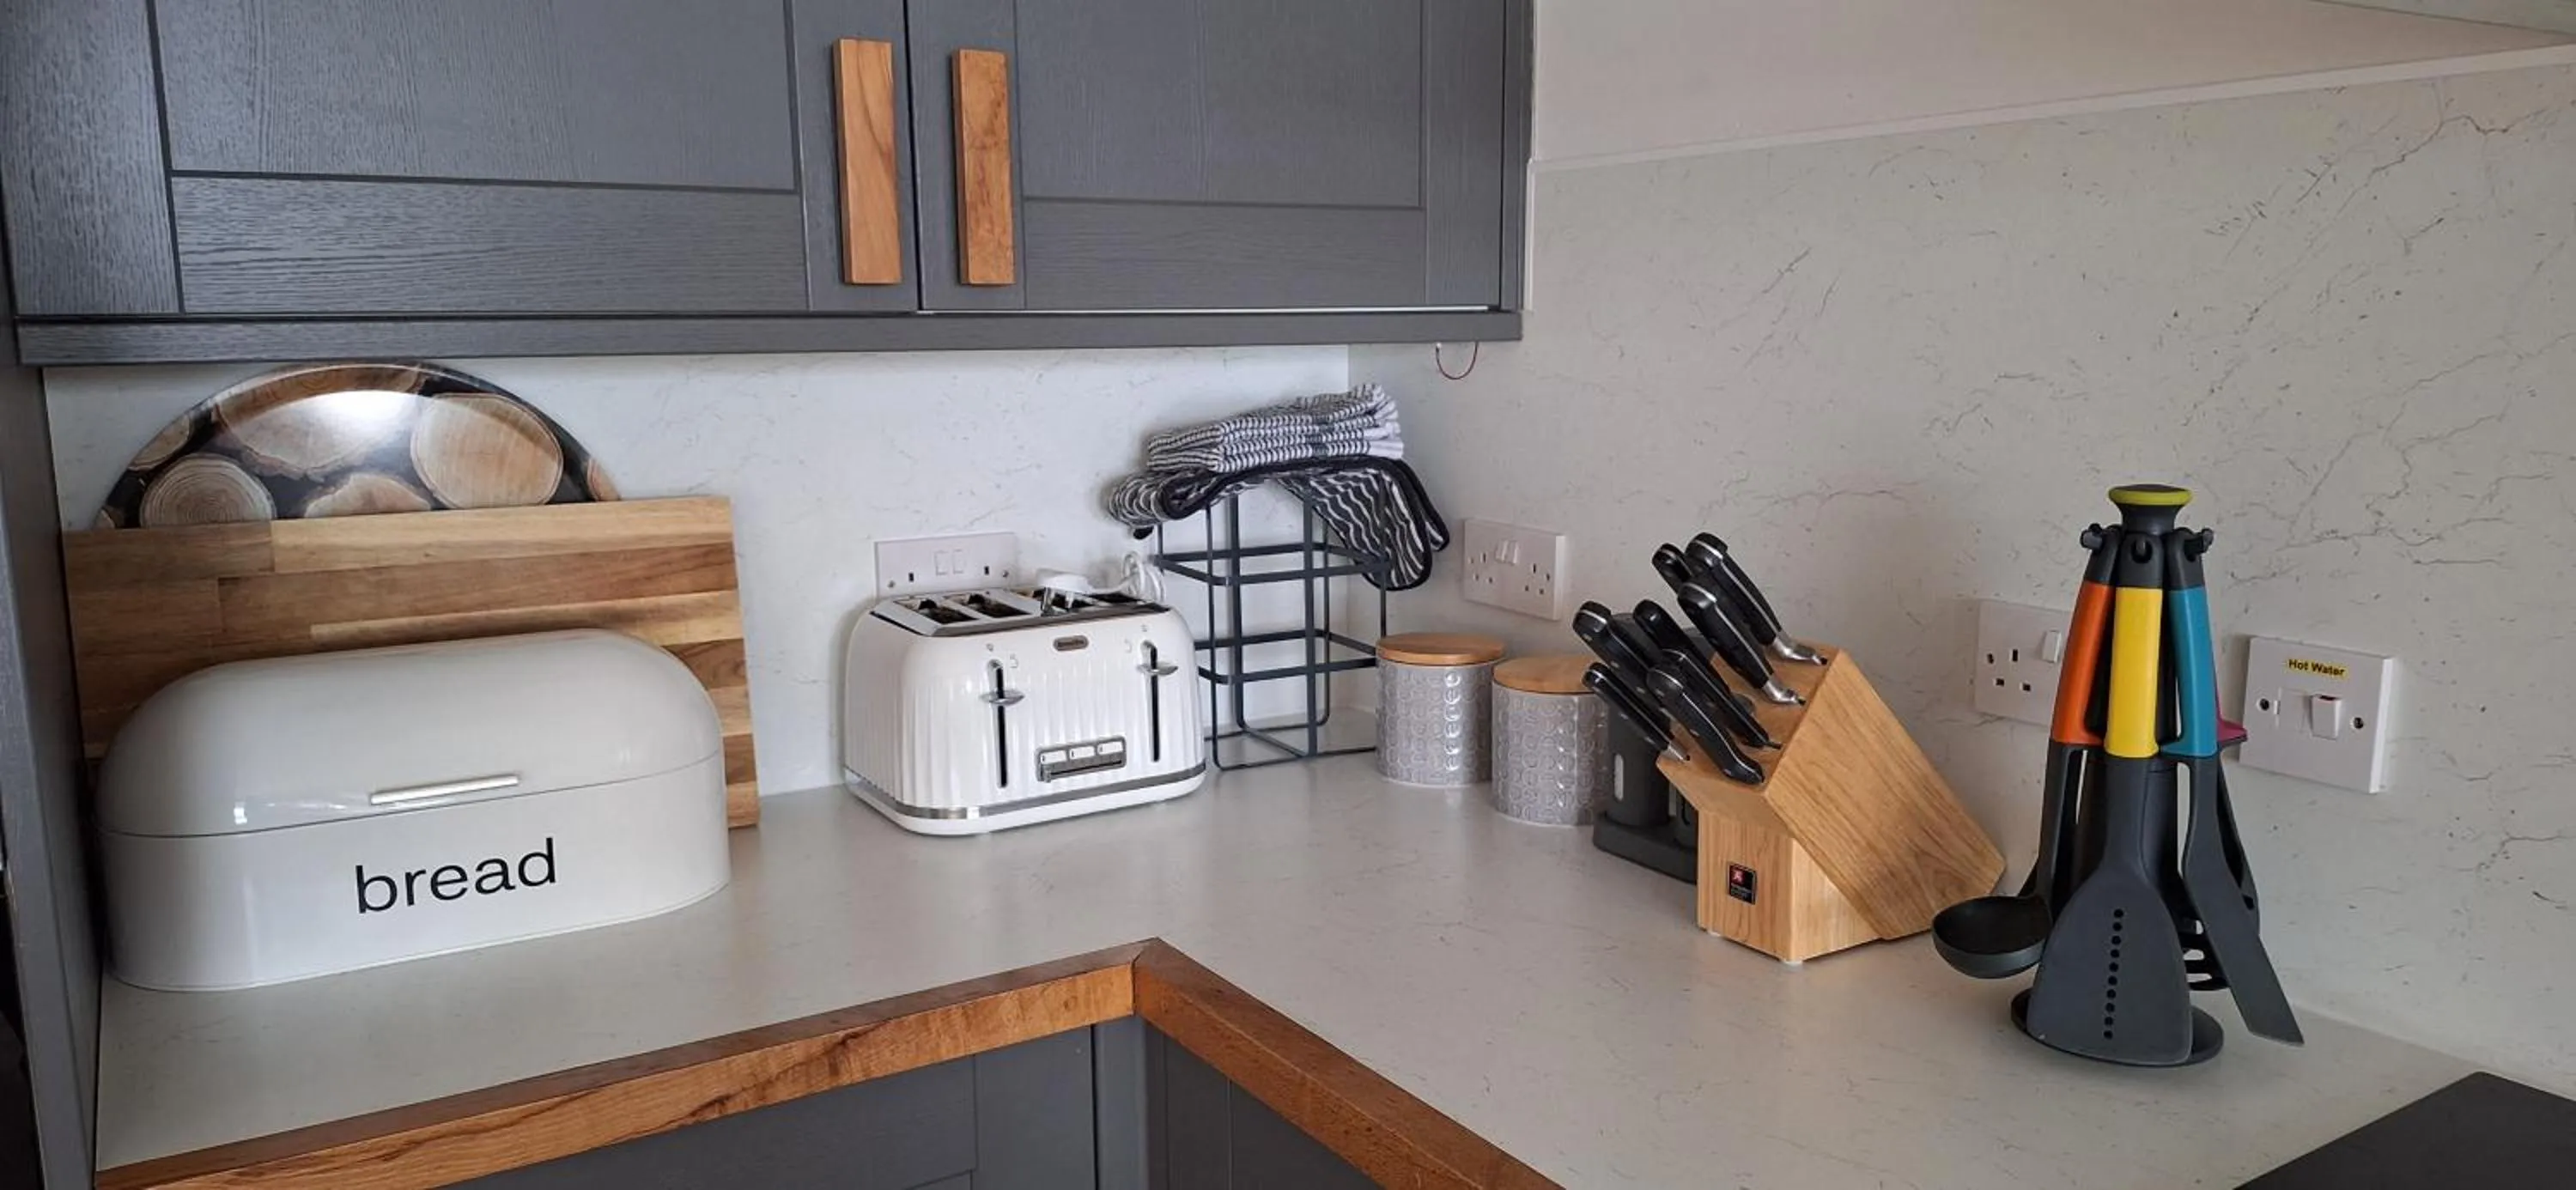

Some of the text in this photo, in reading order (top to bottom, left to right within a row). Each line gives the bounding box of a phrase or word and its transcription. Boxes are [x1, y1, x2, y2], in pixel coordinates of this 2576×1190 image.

[2288, 659, 2345, 676] Hot Water
[355, 837, 556, 914] bread
